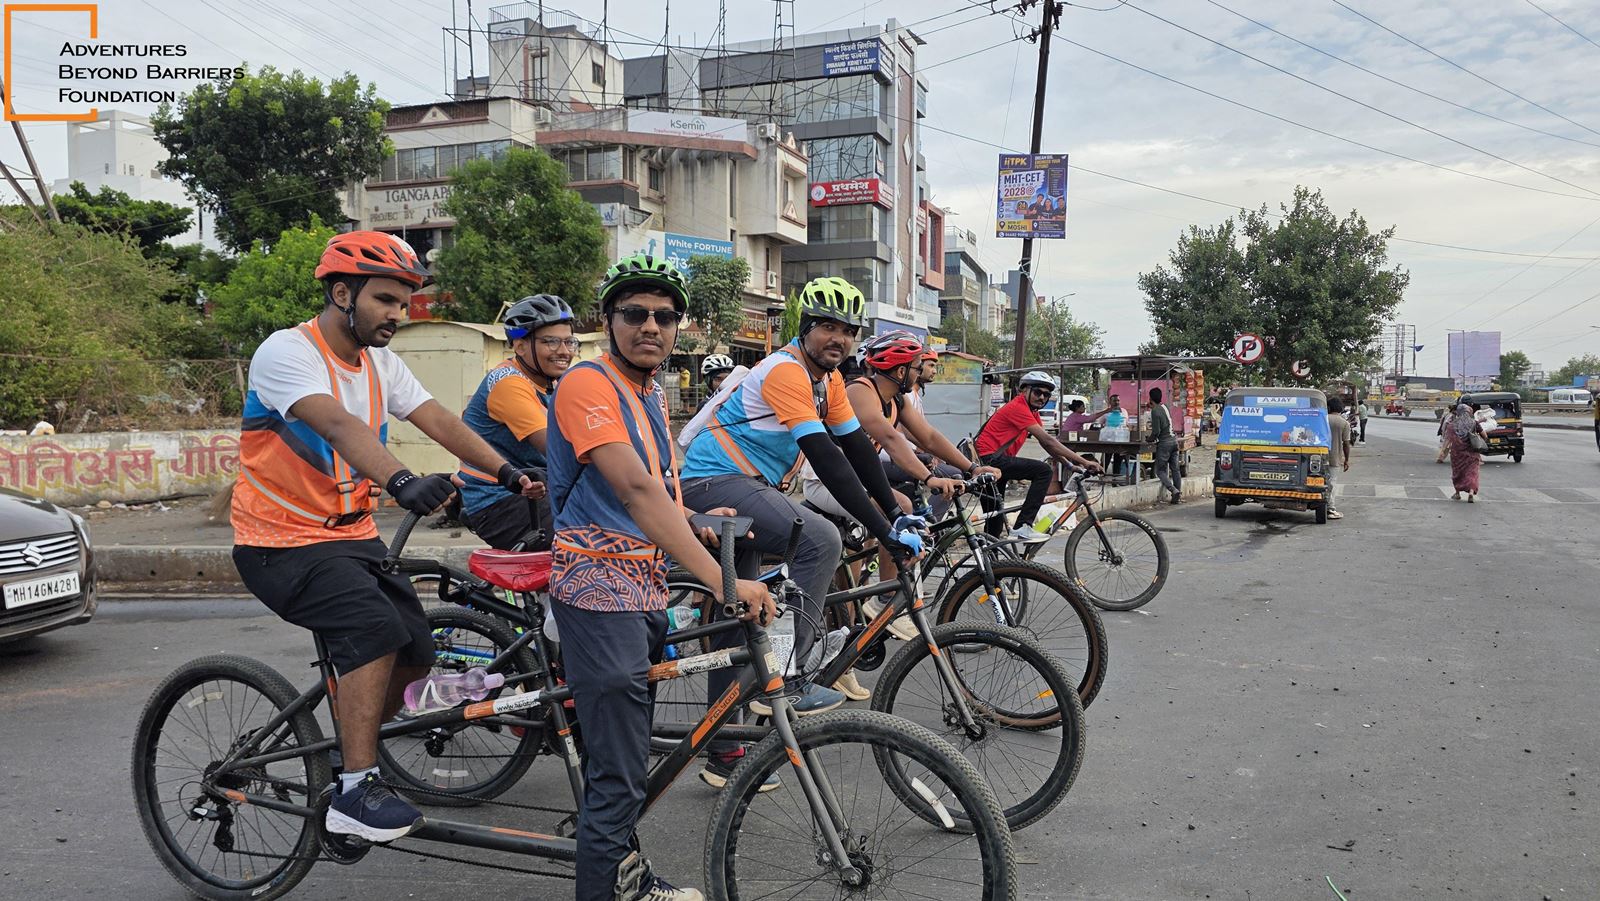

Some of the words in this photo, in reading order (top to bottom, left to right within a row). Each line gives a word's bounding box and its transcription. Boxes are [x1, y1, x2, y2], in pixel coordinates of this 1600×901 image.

[670, 119, 705, 130] kSemin
[1004, 172, 1041, 184] MHT-CET
[831, 180, 869, 192] प्रथमेश
[1004, 187, 1026, 197] 2028
[667, 239, 692, 249] White
[694, 242, 733, 254] FORTUNE
[13, 577, 79, 603] MH14GN4281
